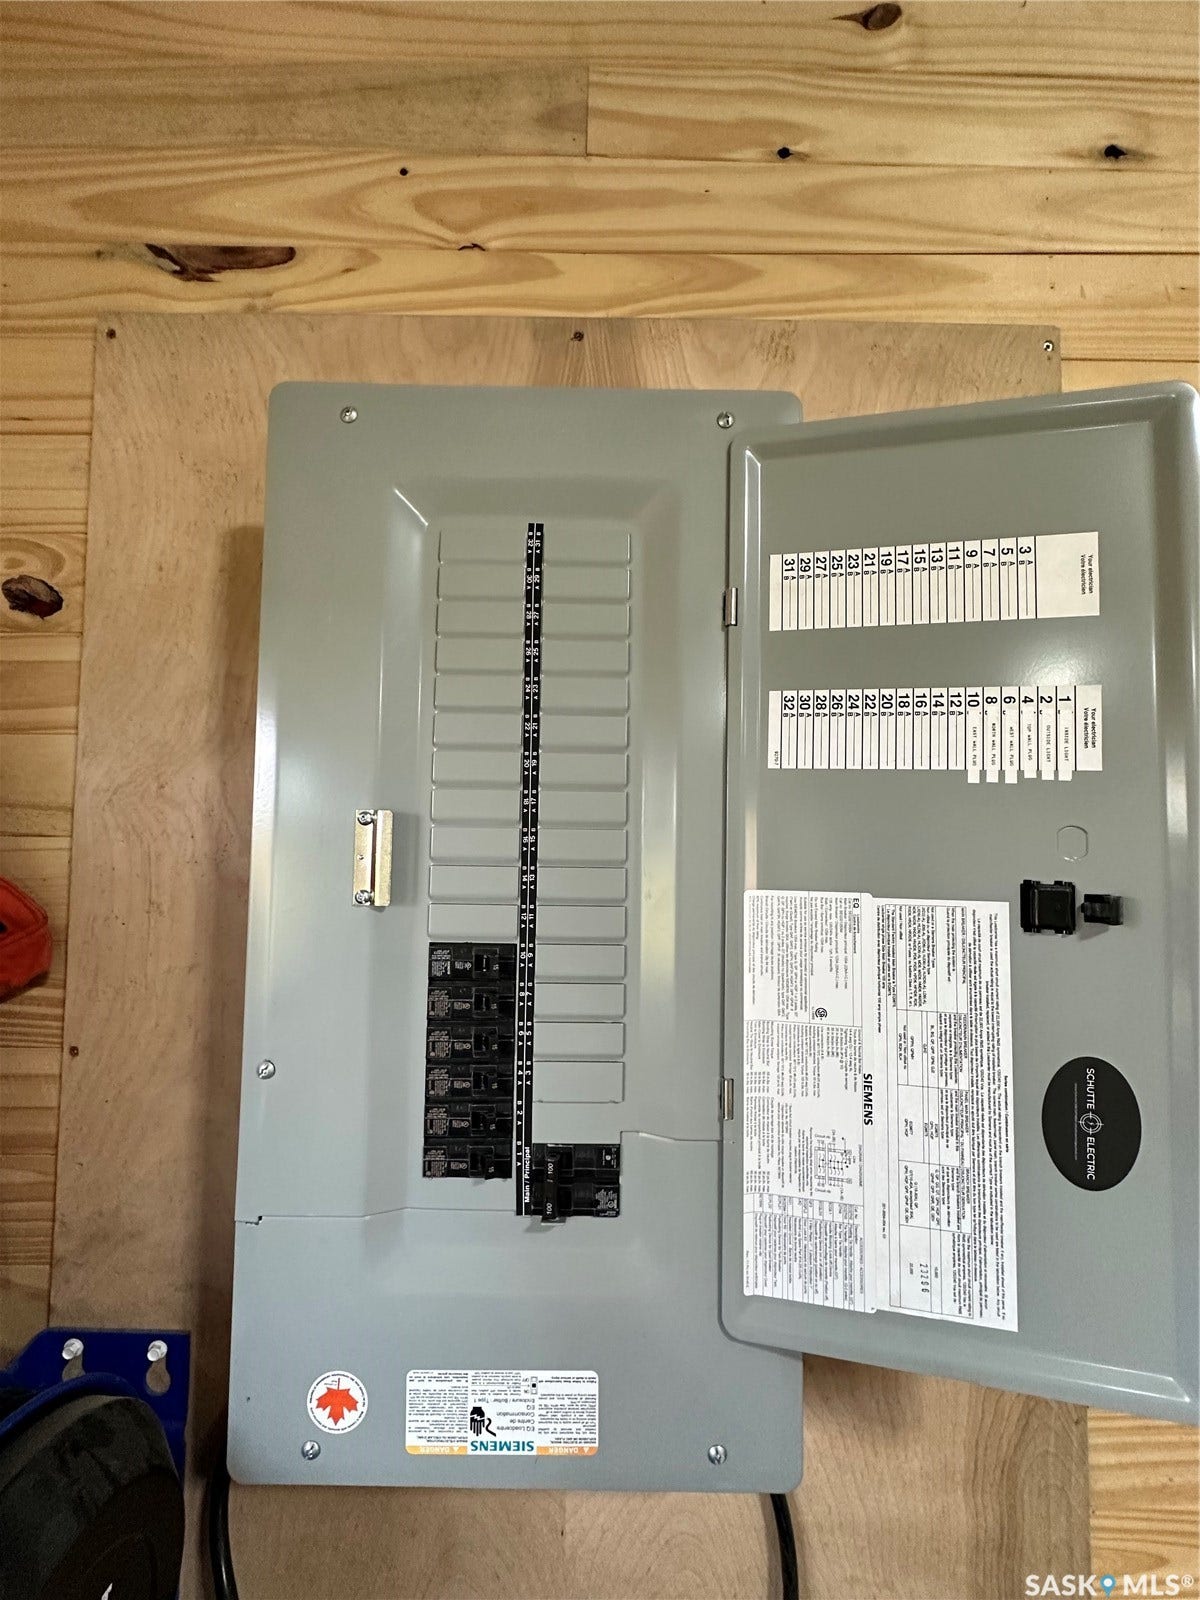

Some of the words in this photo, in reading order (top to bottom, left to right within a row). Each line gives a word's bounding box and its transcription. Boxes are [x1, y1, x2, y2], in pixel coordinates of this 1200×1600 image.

[898, 550, 908, 564] 17
[914, 550, 926, 564] 15
[932, 548, 943, 562] 13
[949, 547, 960, 560] 11
[1020, 546, 1031, 554] 3
[784, 559, 795, 571] 31
[800, 558, 811, 572] 29
[816, 557, 826, 571] 27
[832, 556, 843, 570] 25
[848, 554, 859, 569] 23
[865, 554, 875, 566] 21
[881, 552, 892, 566] 19
[784, 696, 794, 710] 32
[800, 696, 810, 710] 30
[816, 696, 826, 710] 28
[832, 695, 843, 710] 26
[848, 695, 859, 709] 24
[865, 695, 876, 709] 22
[882, 694, 893, 709] 20
[898, 694, 910, 708] 18
[916, 693, 927, 708] 16
[933, 693, 944, 708] 14
[950, 692, 962, 707] 12
[968, 692, 980, 707] 10
[986, 696, 997, 704] 8
[1004, 696, 1016, 704] 6
[1022, 696, 1034, 704] 4
[853, 898, 859, 908] EQ
[1086, 1068, 1095, 1109] SCHUTTE
[864, 1073, 873, 1125] SIEMENS
[1087, 1137, 1095, 1180] ELECTRIC
[470, 1441, 534, 1452] SIEMENS
